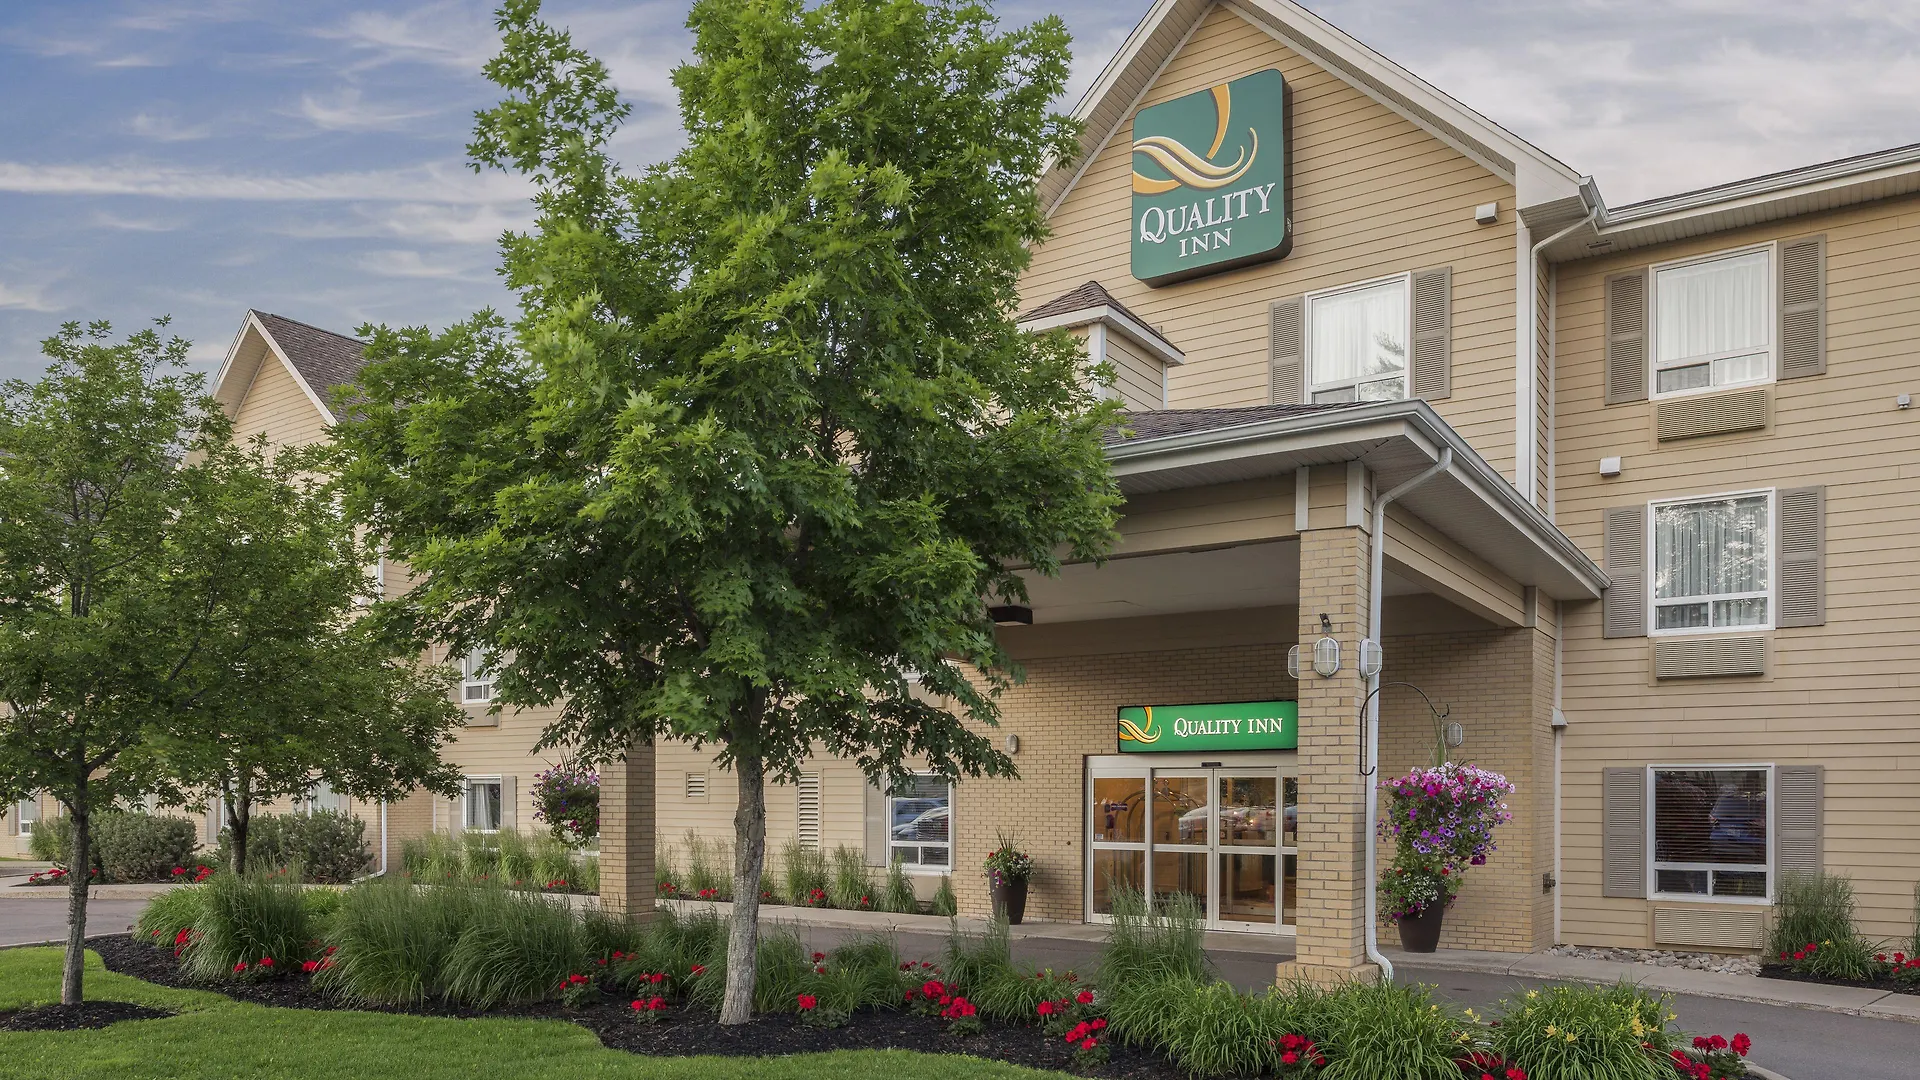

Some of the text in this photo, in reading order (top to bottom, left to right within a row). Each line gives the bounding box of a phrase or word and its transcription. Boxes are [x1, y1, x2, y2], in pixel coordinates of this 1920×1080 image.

[1140, 183, 1275, 244] QUALITY
[1179, 228, 1232, 257] INN
[1174, 717, 1283, 737] QUALITY INN
